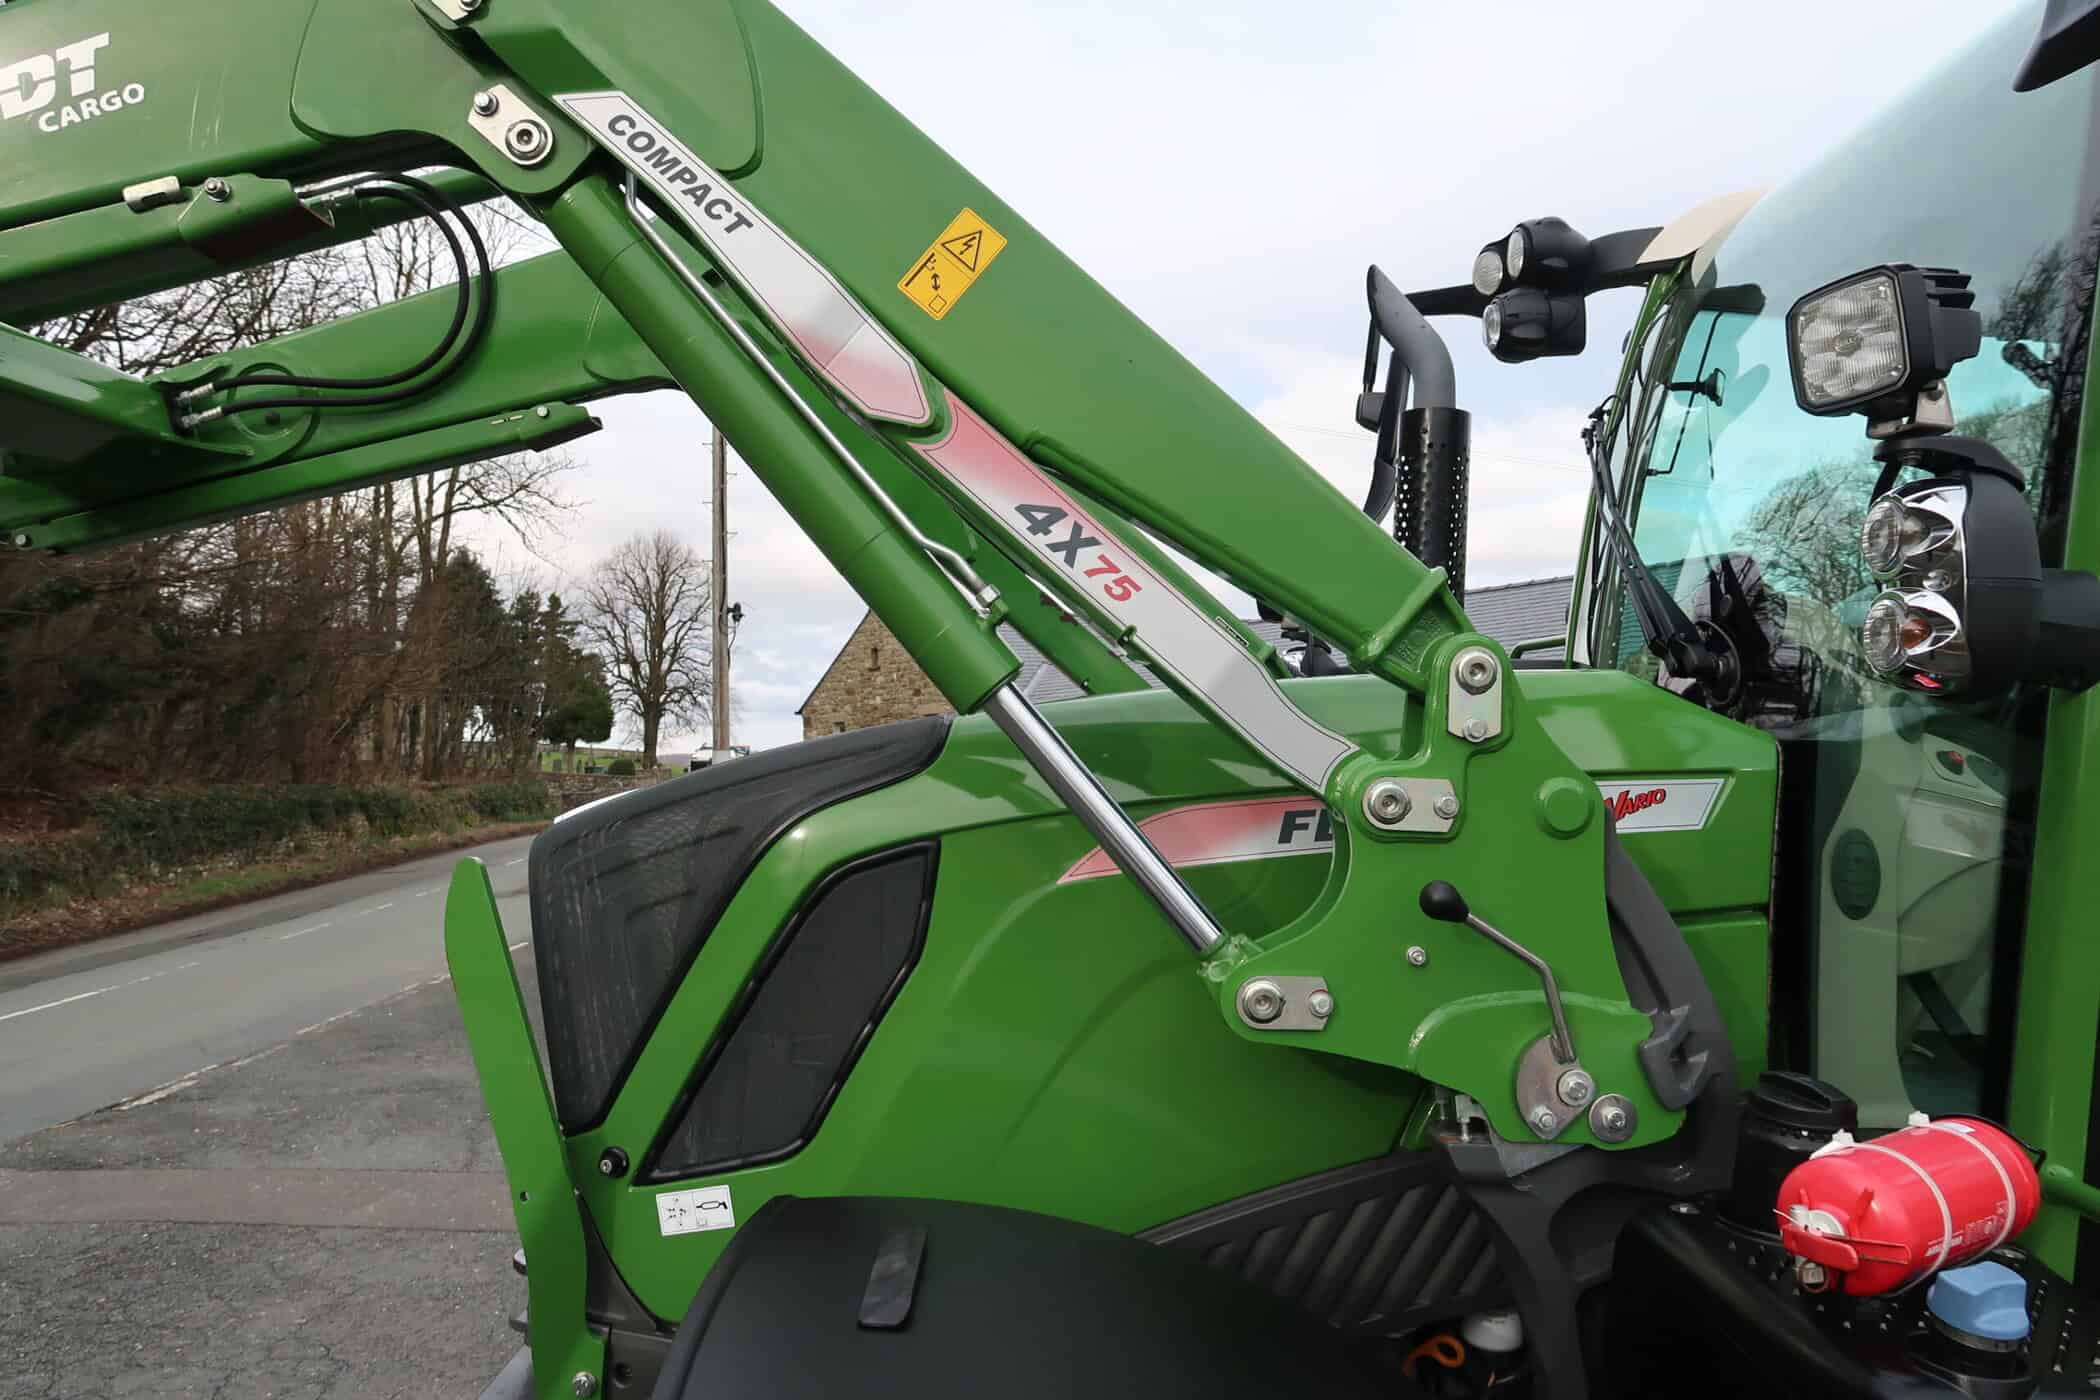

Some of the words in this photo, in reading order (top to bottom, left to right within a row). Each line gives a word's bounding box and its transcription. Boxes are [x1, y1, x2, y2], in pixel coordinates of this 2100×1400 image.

[38, 83, 144, 132] CARGO
[608, 114, 754, 234] COMPACT
[1014, 503, 1143, 602] 4X75
